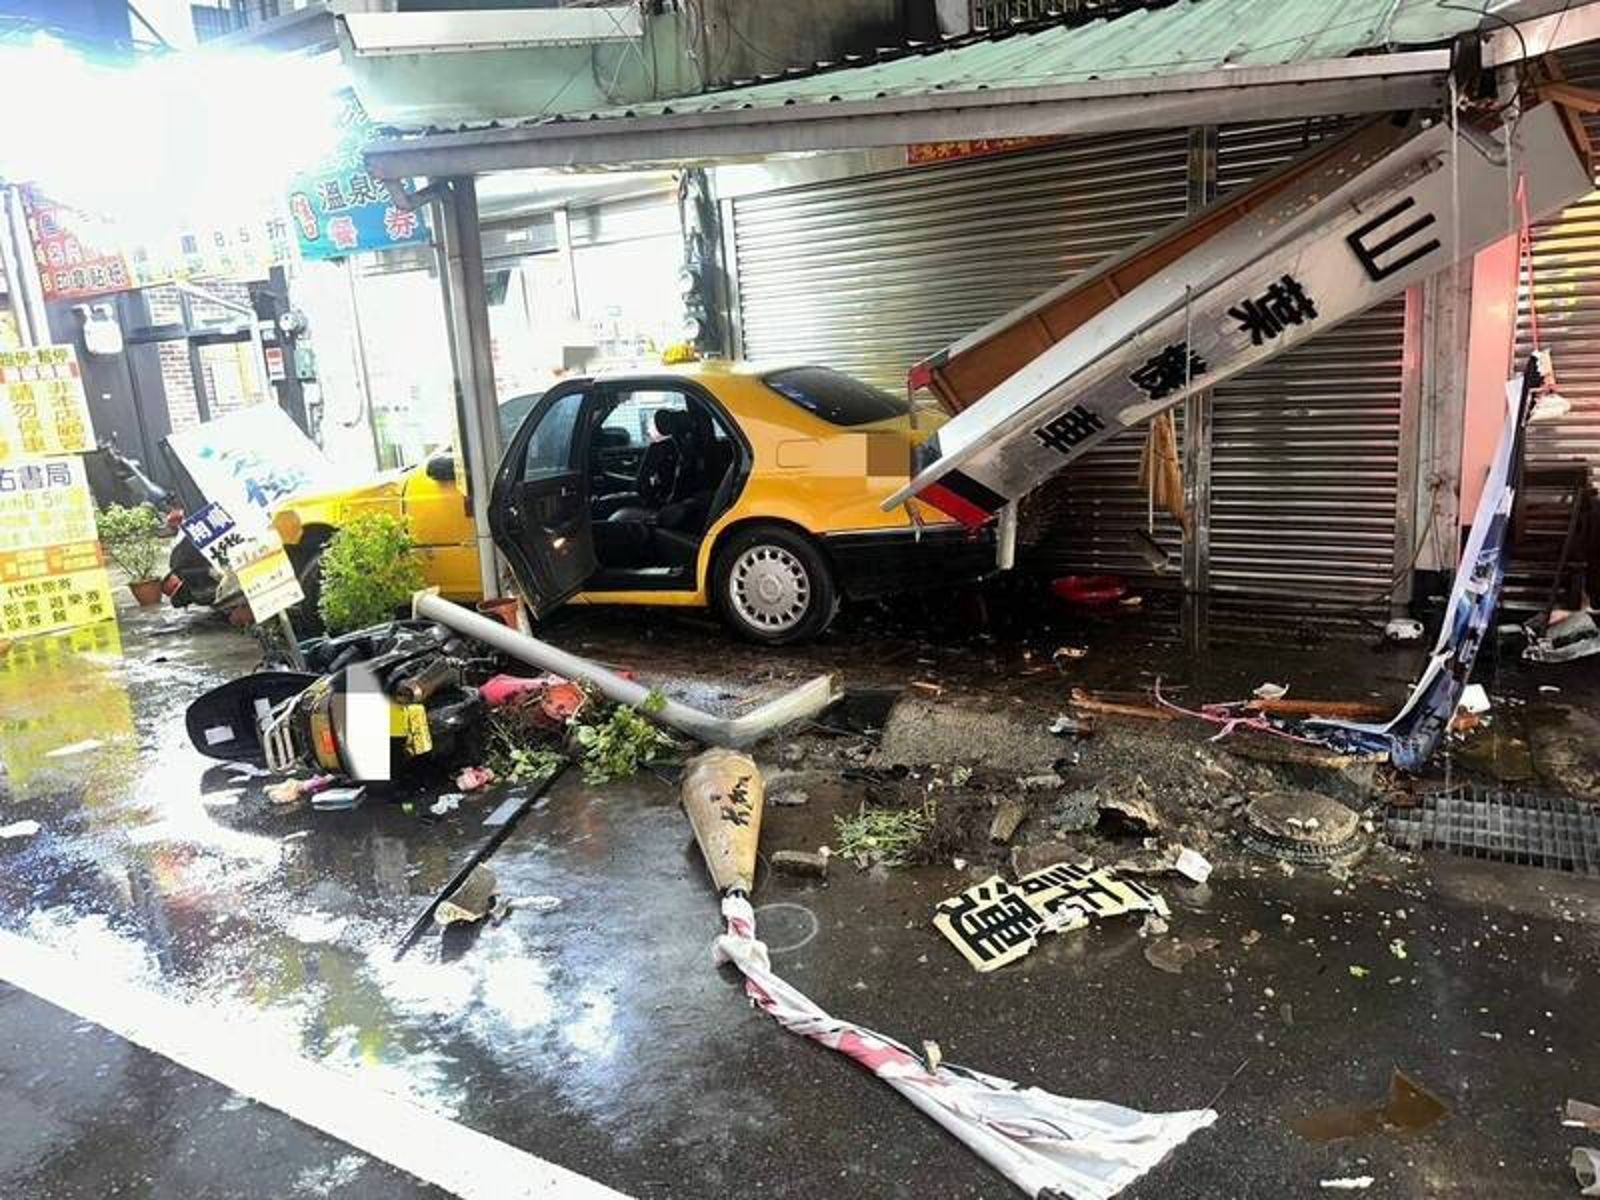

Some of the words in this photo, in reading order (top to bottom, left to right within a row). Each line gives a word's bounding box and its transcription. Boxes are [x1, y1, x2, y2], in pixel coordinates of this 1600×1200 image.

[1033, 196, 1441, 454] 山葉機車
[937, 863, 1159, 962] 託運
